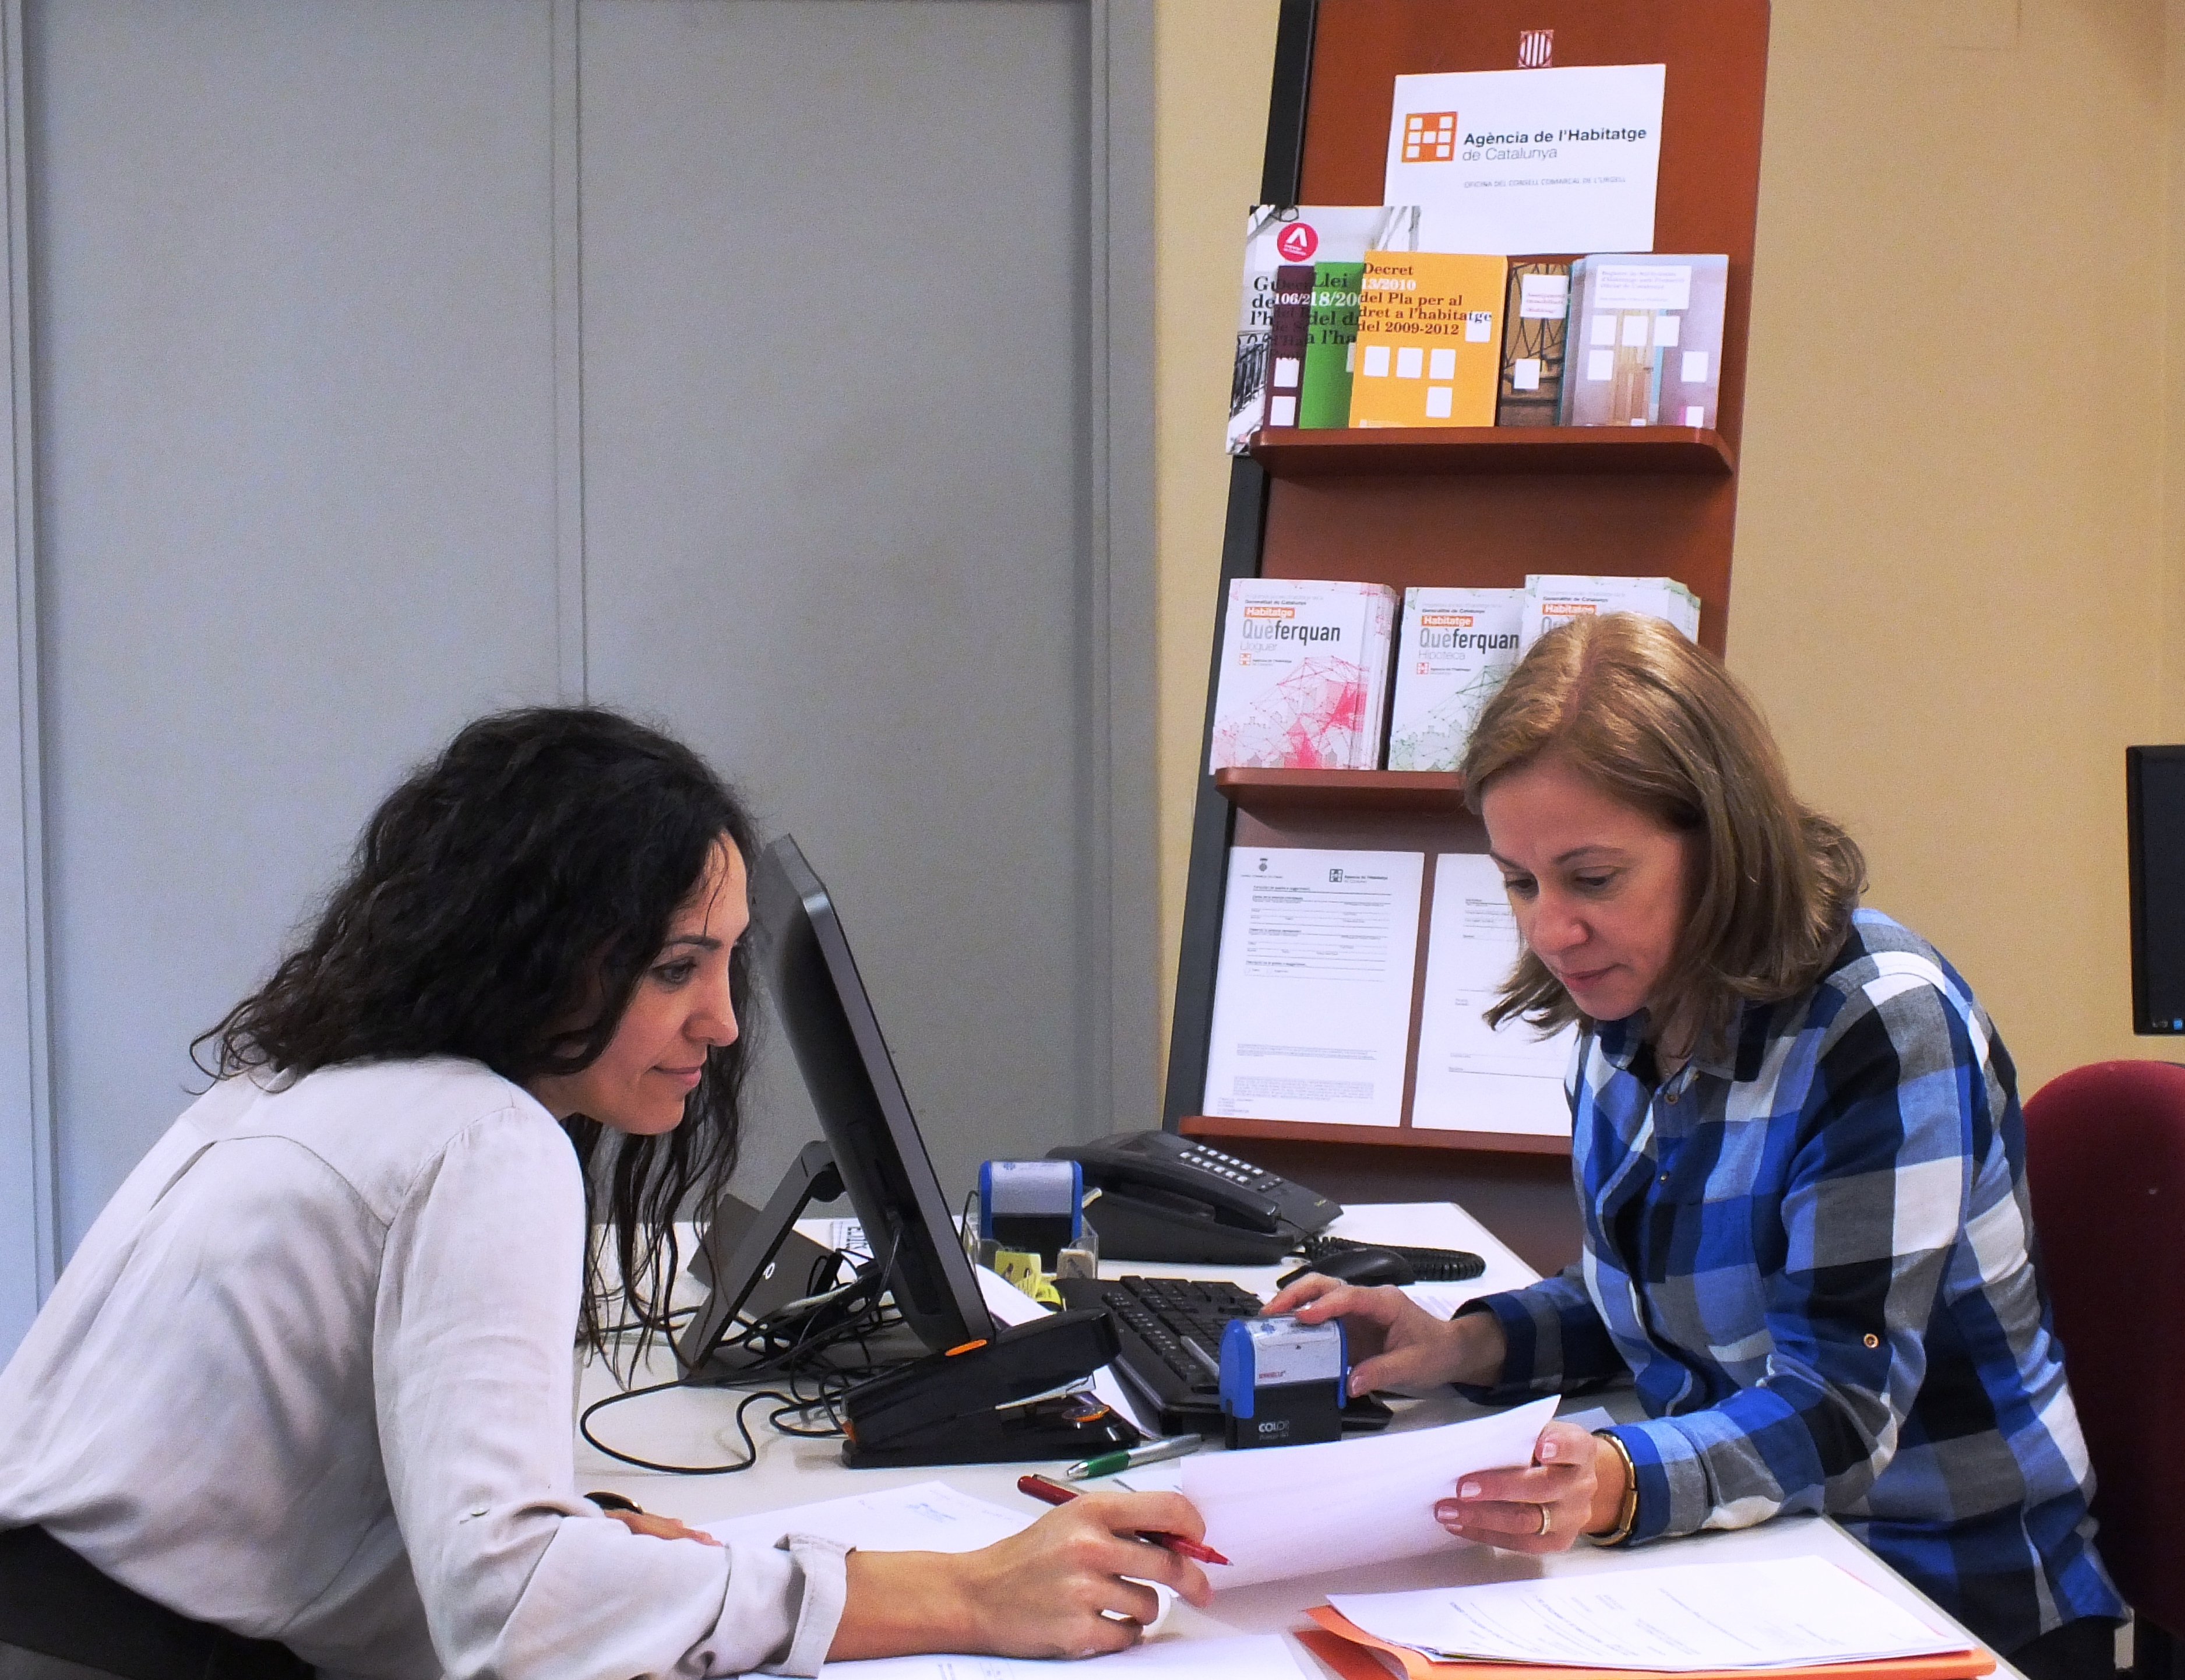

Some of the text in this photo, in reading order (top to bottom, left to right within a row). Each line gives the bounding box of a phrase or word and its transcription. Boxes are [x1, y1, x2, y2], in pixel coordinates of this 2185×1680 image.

[1464, 128, 1647, 147] Agència de l'Habitatge
[1462, 147, 1557, 161] de Catalunya
[1364, 262, 1414, 275] Decret
[1312, 291, 1361, 307] 18/20
[1360, 292, 1463, 307] del Pla per al
[1359, 306, 1492, 323] dret a l'habitatge
[1358, 320, 1460, 335] del 2009-2012
[1246, 607, 1293, 618] Habitatge
[1423, 616, 1472, 626] Habitatge
